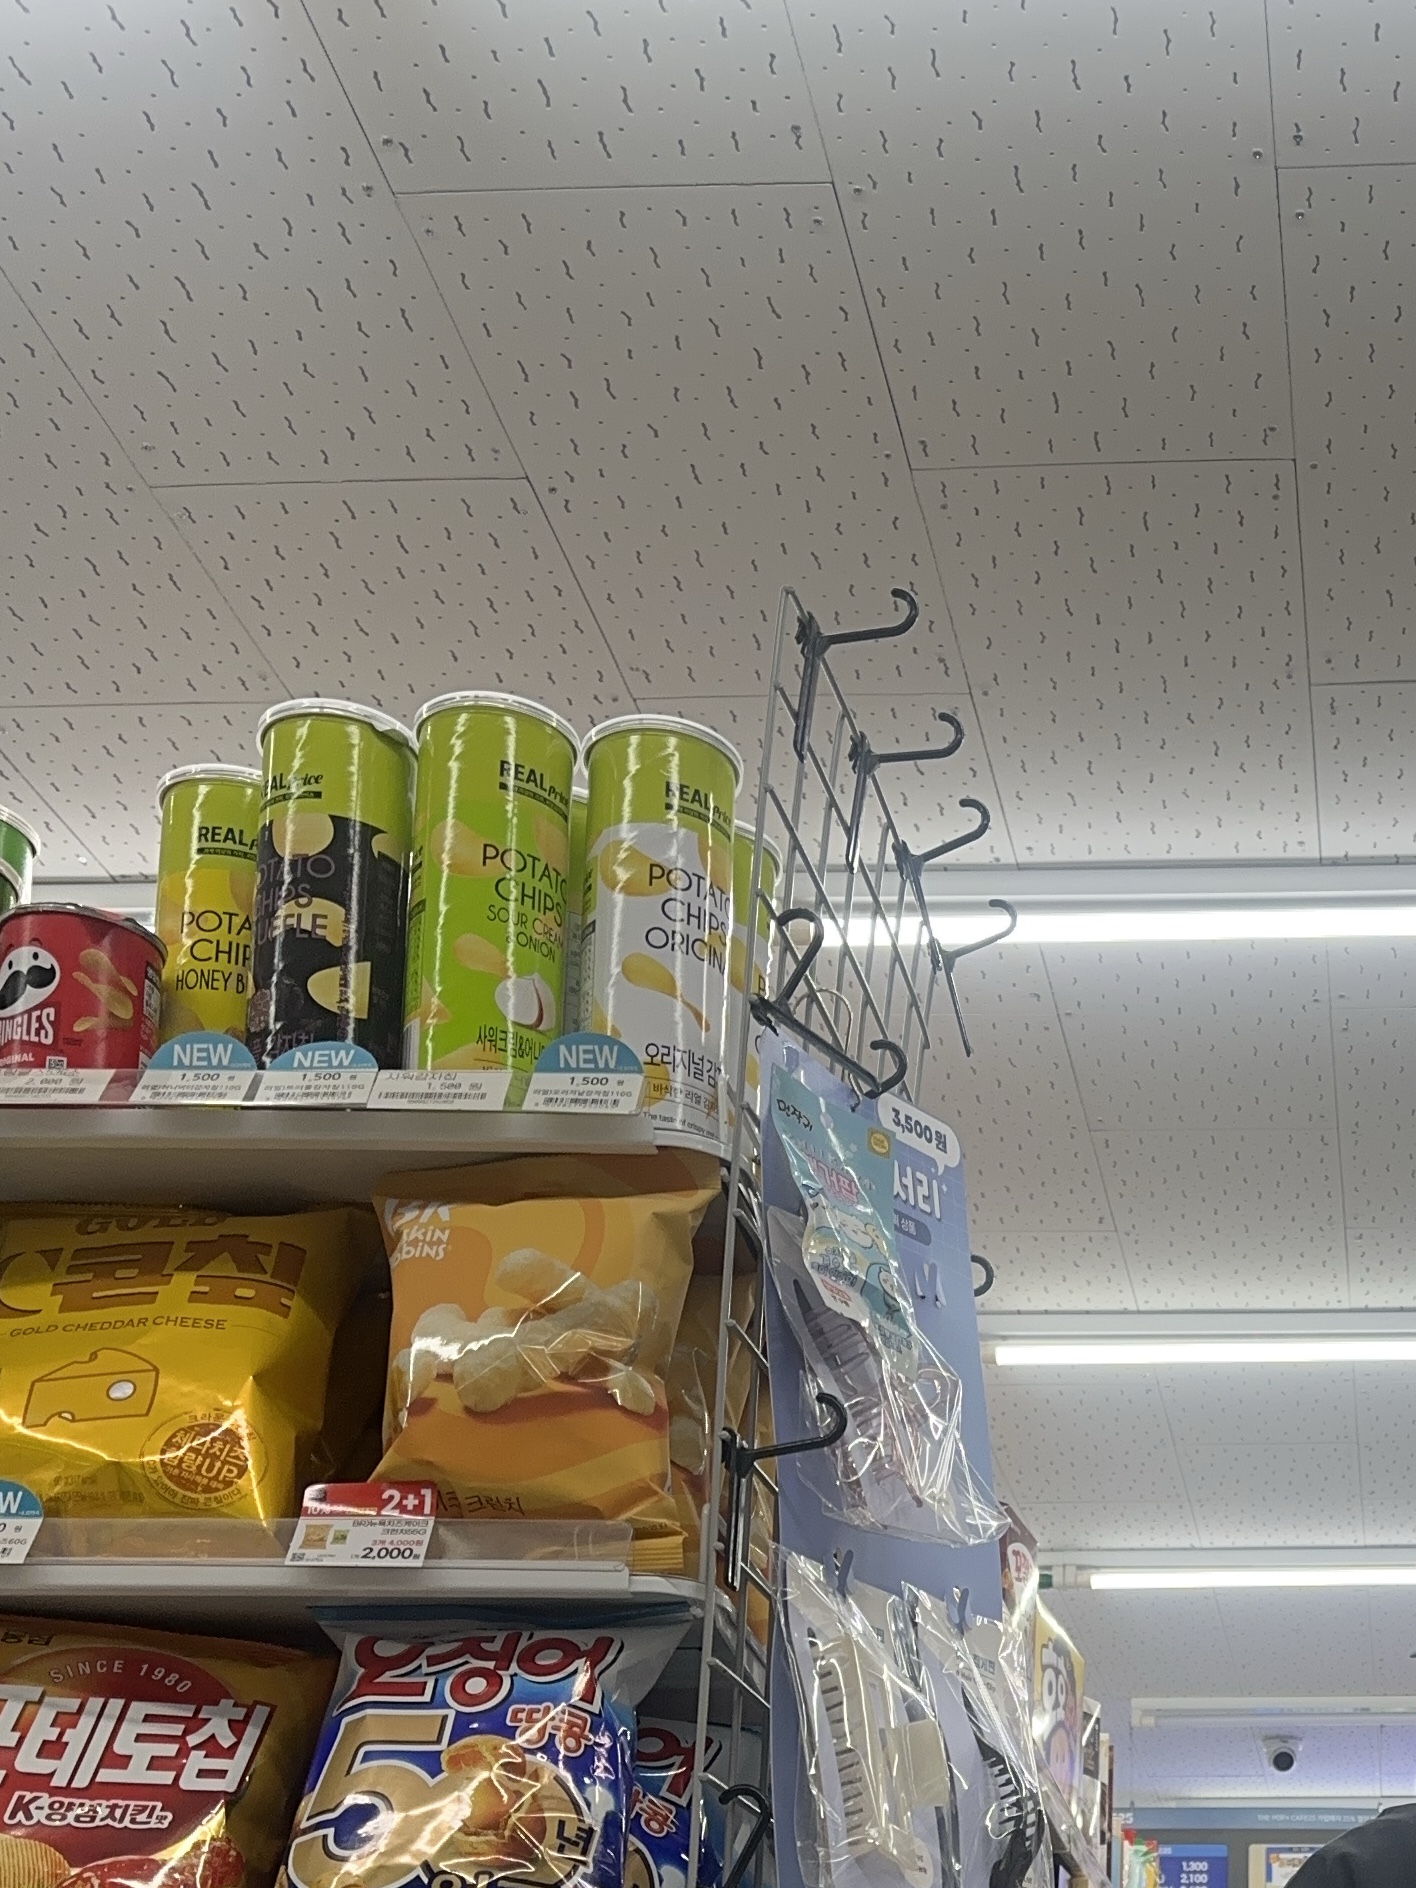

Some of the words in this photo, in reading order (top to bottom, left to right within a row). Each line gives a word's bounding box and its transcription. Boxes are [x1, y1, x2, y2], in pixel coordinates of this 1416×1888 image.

[176, 968, 232, 992] HONEY
[173, 1043, 233, 1067] NEW
[293, 1050, 355, 1068] NEW
[559, 1045, 618, 1069] NEW
[179, 1072, 221, 1083] 1,500
[301, 1072, 342, 1082] 1,500
[569, 1075, 609, 1086] 1,500
[61, 1316, 149, 1333] CHEDDAR
[152, 1314, 228, 1331] CHEESE
[381, 1488, 432, 1515] 2+1
[50, 1659, 125, 1683] SINCE
[138, 1662, 193, 1694] 1980
[336, 1631, 616, 1712] 오징어
